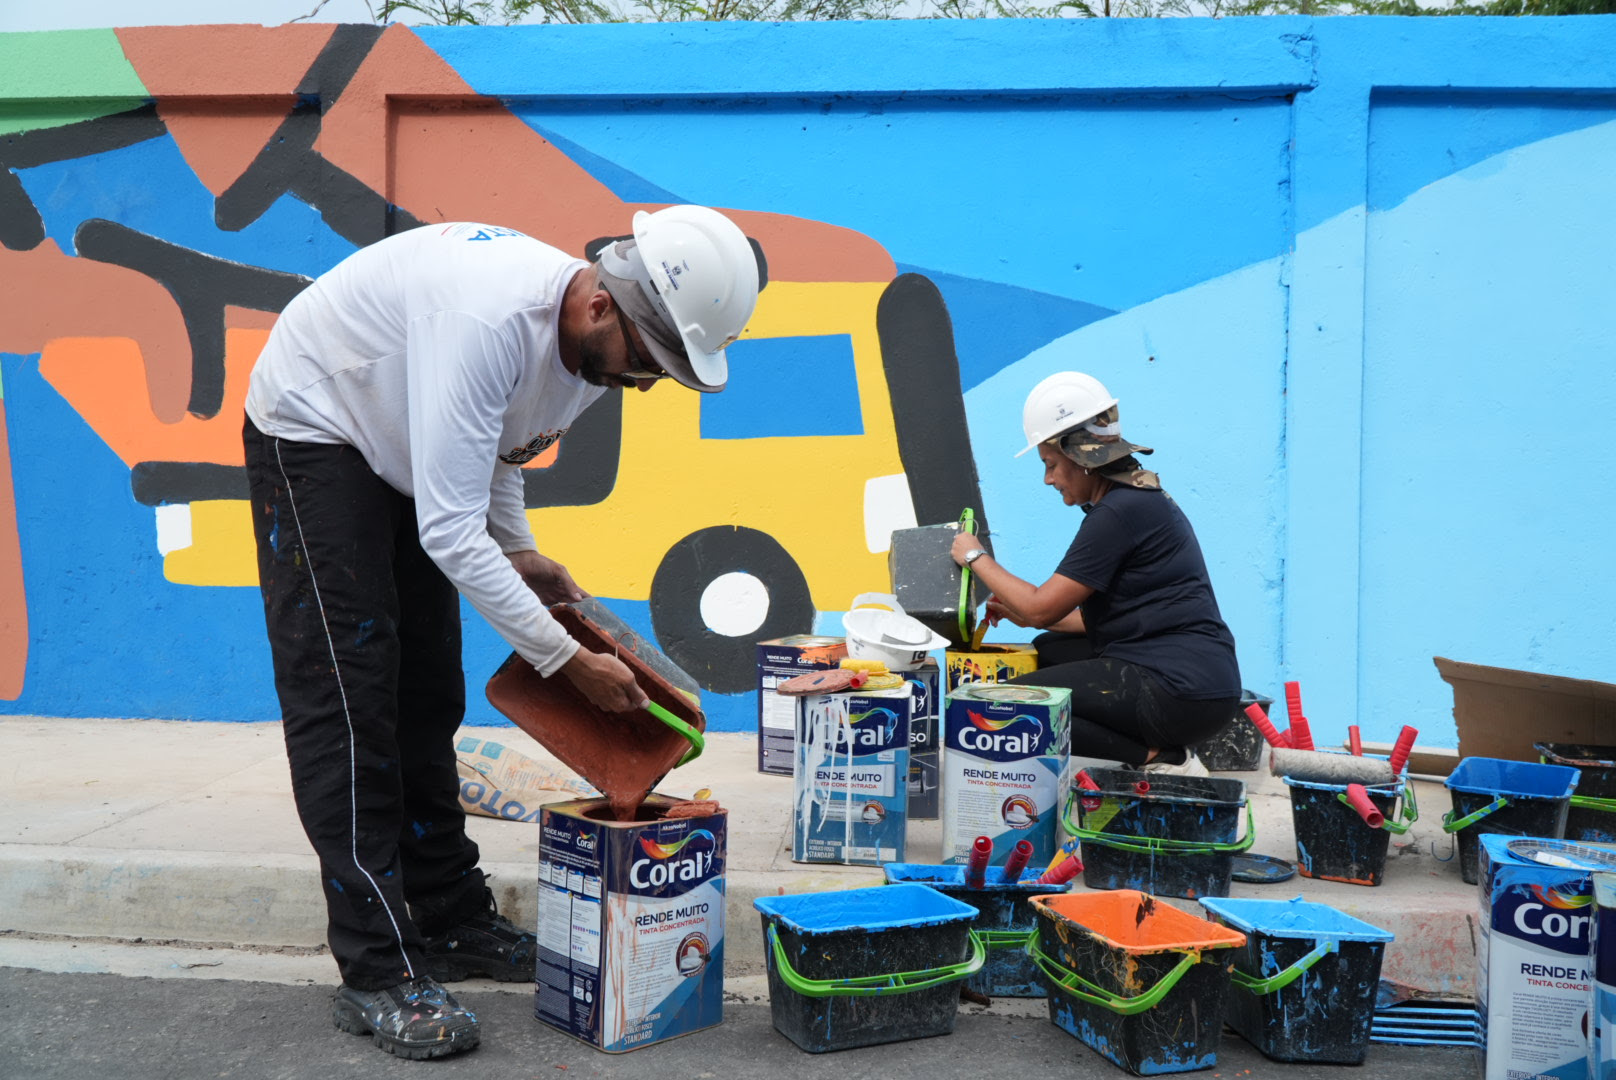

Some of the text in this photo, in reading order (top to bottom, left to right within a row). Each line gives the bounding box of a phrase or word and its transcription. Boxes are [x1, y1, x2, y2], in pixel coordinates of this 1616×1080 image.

[958, 726, 1029, 754] Coral
[815, 771, 845, 781] ENDE
[963, 768, 1036, 783] RENDE MUITO
[985, 781, 1032, 789] CONCENTRADA
[543, 826, 572, 840] RENDE MUITO
[576, 836, 594, 850] Coral
[808, 851, 835, 859] STANDARD
[629, 851, 703, 889] Coral
[635, 902, 709, 927] RENDE MUITO
[1514, 902, 1589, 939] Cor
[639, 916, 705, 935] TINTA CONCENTRADA
[1520, 962, 1577, 980] RENDE
[1527, 978, 1553, 988] TINTA
[624, 1030, 653, 1046] STANDARD
